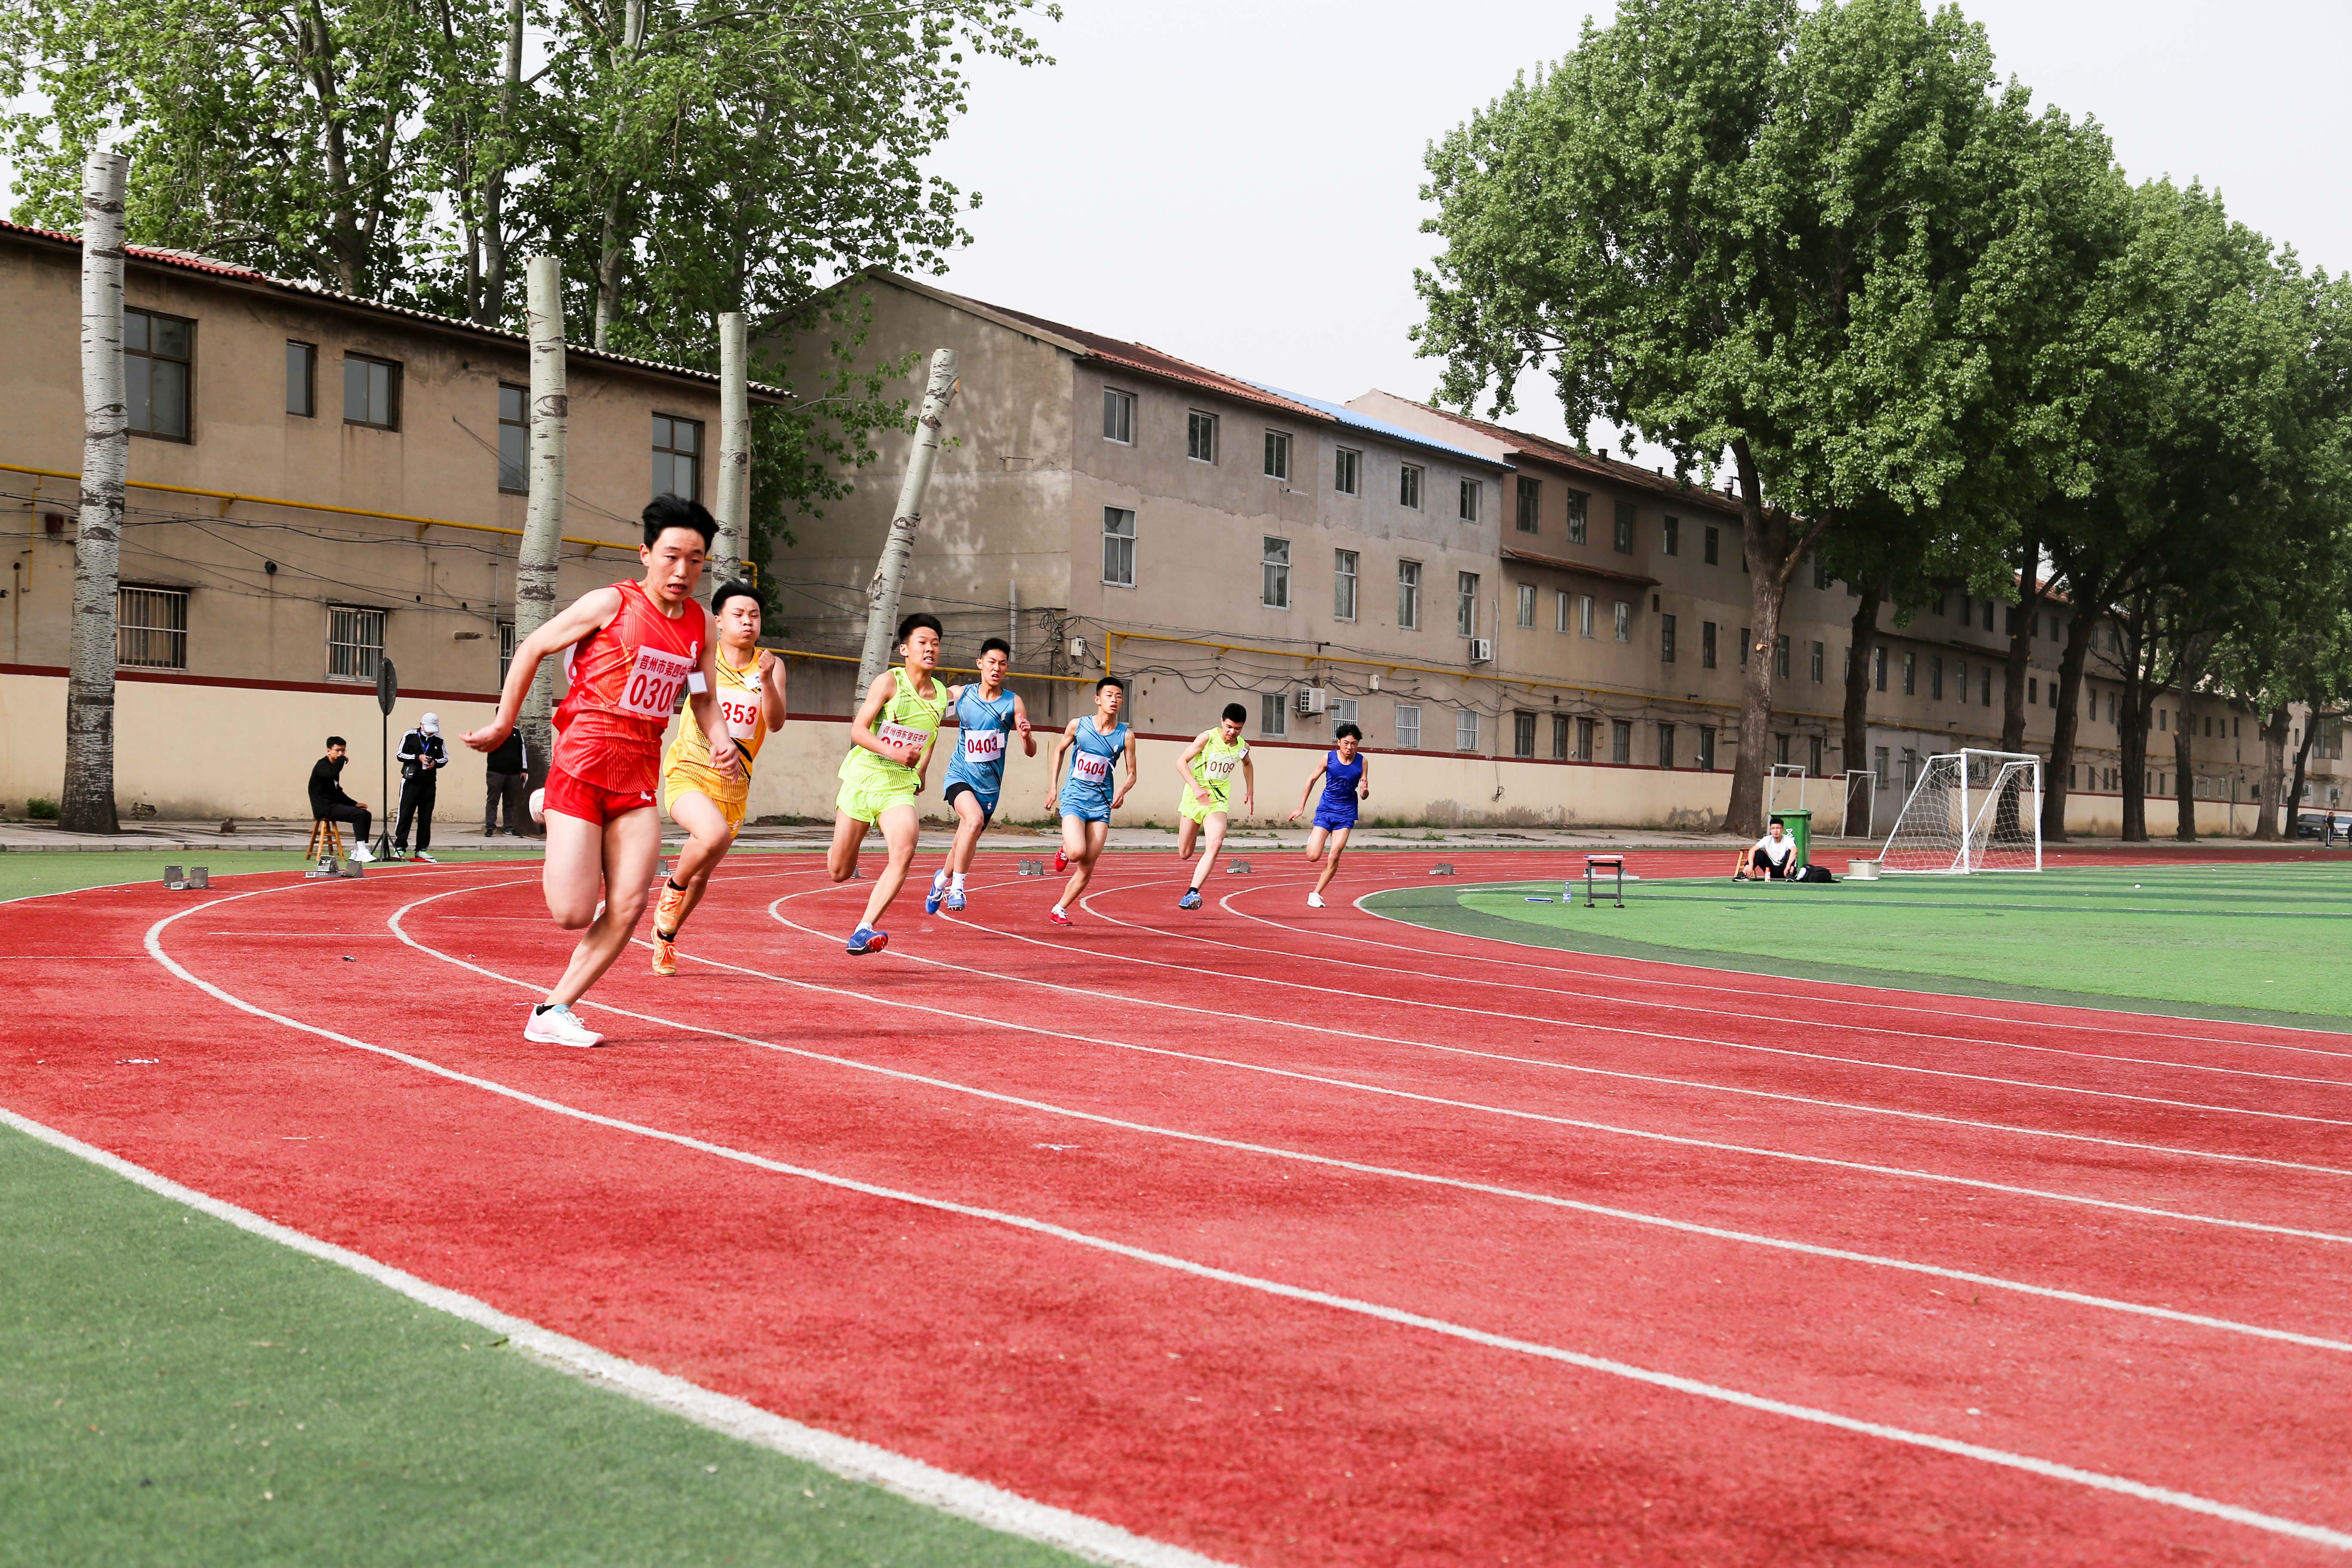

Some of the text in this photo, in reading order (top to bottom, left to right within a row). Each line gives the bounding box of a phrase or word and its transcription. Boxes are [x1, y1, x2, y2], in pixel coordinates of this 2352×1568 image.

[883, 726, 928, 742] 晋州市东里庄中学
[968, 737, 997, 753] 0403
[1078, 759, 1106, 776] 0404
